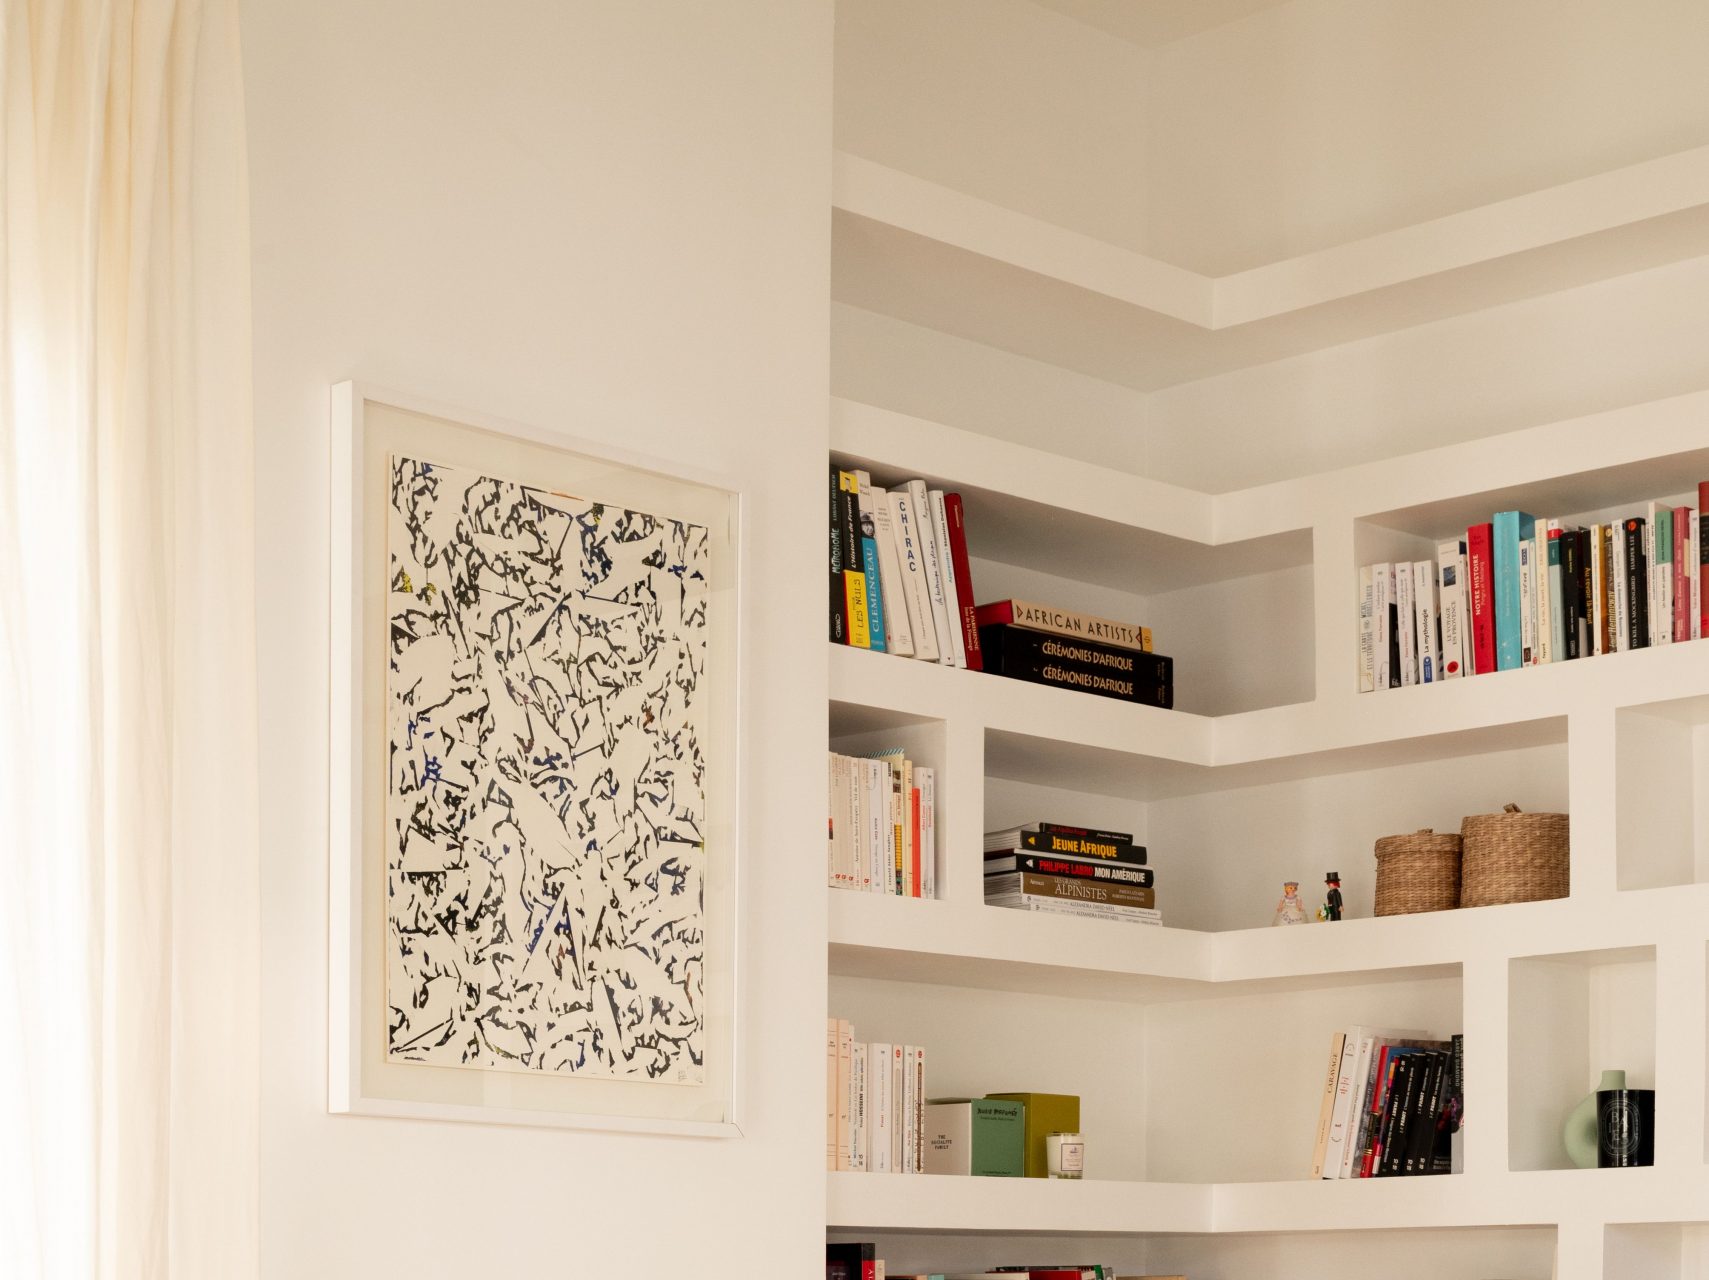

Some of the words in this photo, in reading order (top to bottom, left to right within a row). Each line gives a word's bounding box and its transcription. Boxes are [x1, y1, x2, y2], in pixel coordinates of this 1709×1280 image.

[899, 501, 917, 572] CHIRAC
[1472, 554, 1480, 589] HISTOIRE
[866, 547, 880, 632] CLEMENCEAU
[1026, 608, 1082, 631] AFRICAN
[1088, 622, 1133, 643] ARTISTS
[1422, 608, 1430, 644] mythologie
[1042, 639, 1092, 662] CÉRÉMONIES
[1093, 653, 1133, 671] D'AFRIQUE
[1042, 664, 1092, 687] CÉRÉMONIES
[1093, 676, 1133, 695] D'AFRIQUE
[1052, 836, 1079, 852] JEUNE
[1079, 839, 1117, 858] AFRIQUE
[1039, 860, 1069, 874] PHILIPPE
[1094, 866, 1110, 879] MON
[1111, 867, 1145, 883] AMÉRIQUE
[1054, 883, 1107, 900] ALPINISTES
